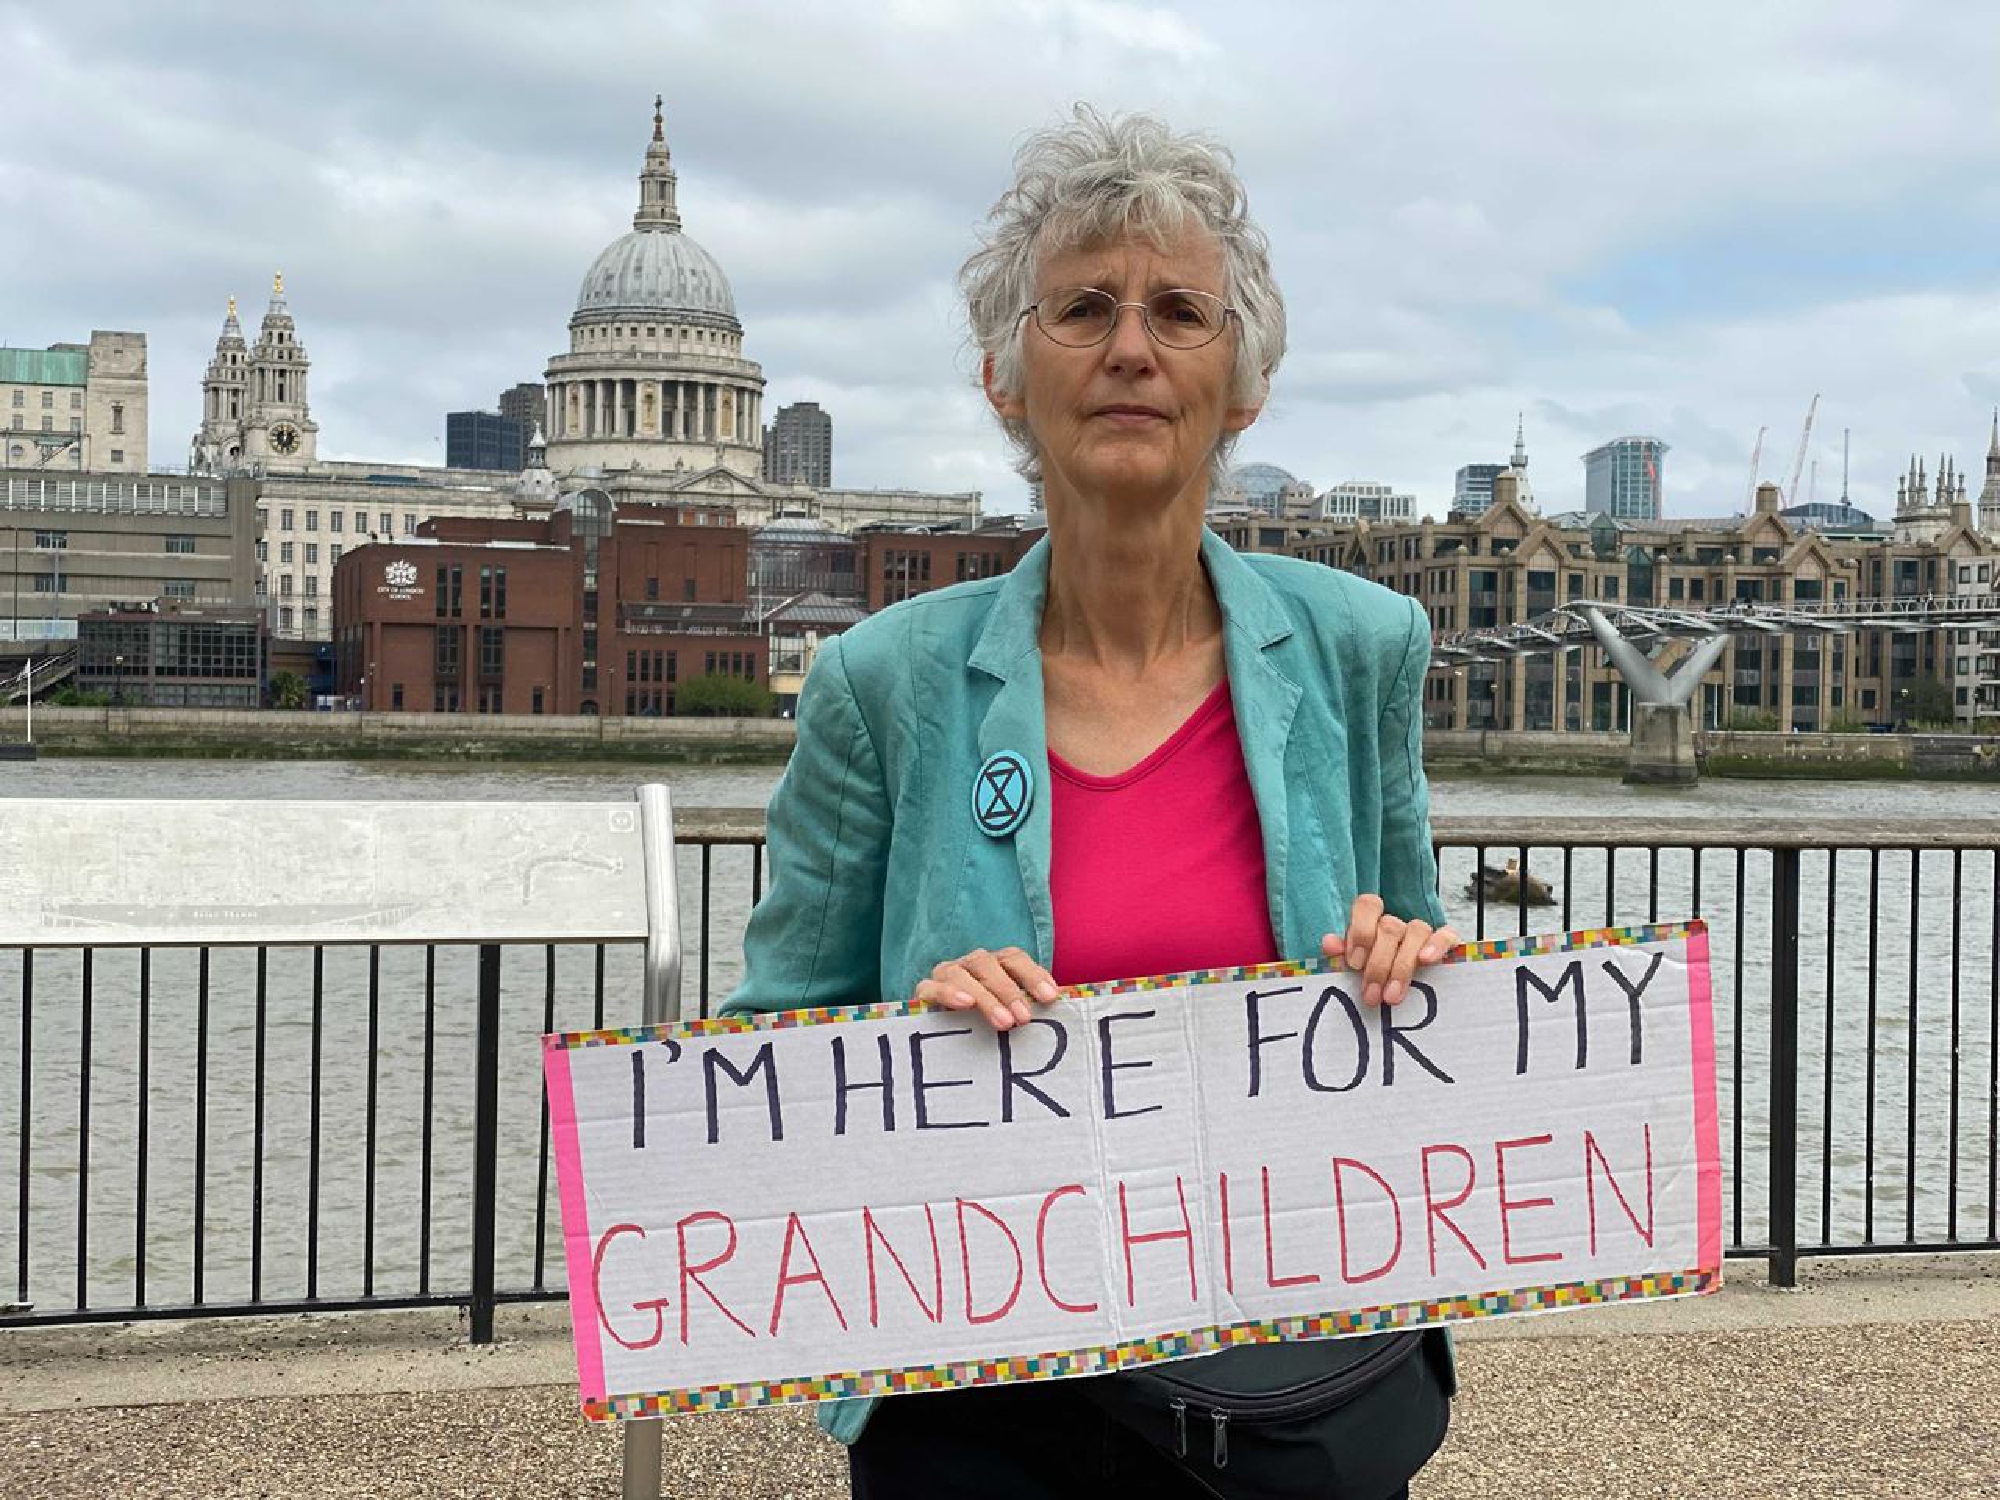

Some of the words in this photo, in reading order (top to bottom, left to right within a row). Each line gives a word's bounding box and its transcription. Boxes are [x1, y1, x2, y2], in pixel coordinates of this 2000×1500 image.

[631, 1038, 784, 1149] I'M
[832, 1010, 1163, 1137] HERE
[1246, 980, 1455, 1098] FOR
[1515, 952, 1665, 1076] MY
[592, 1122, 1655, 1351] GRANDCHILDREN
